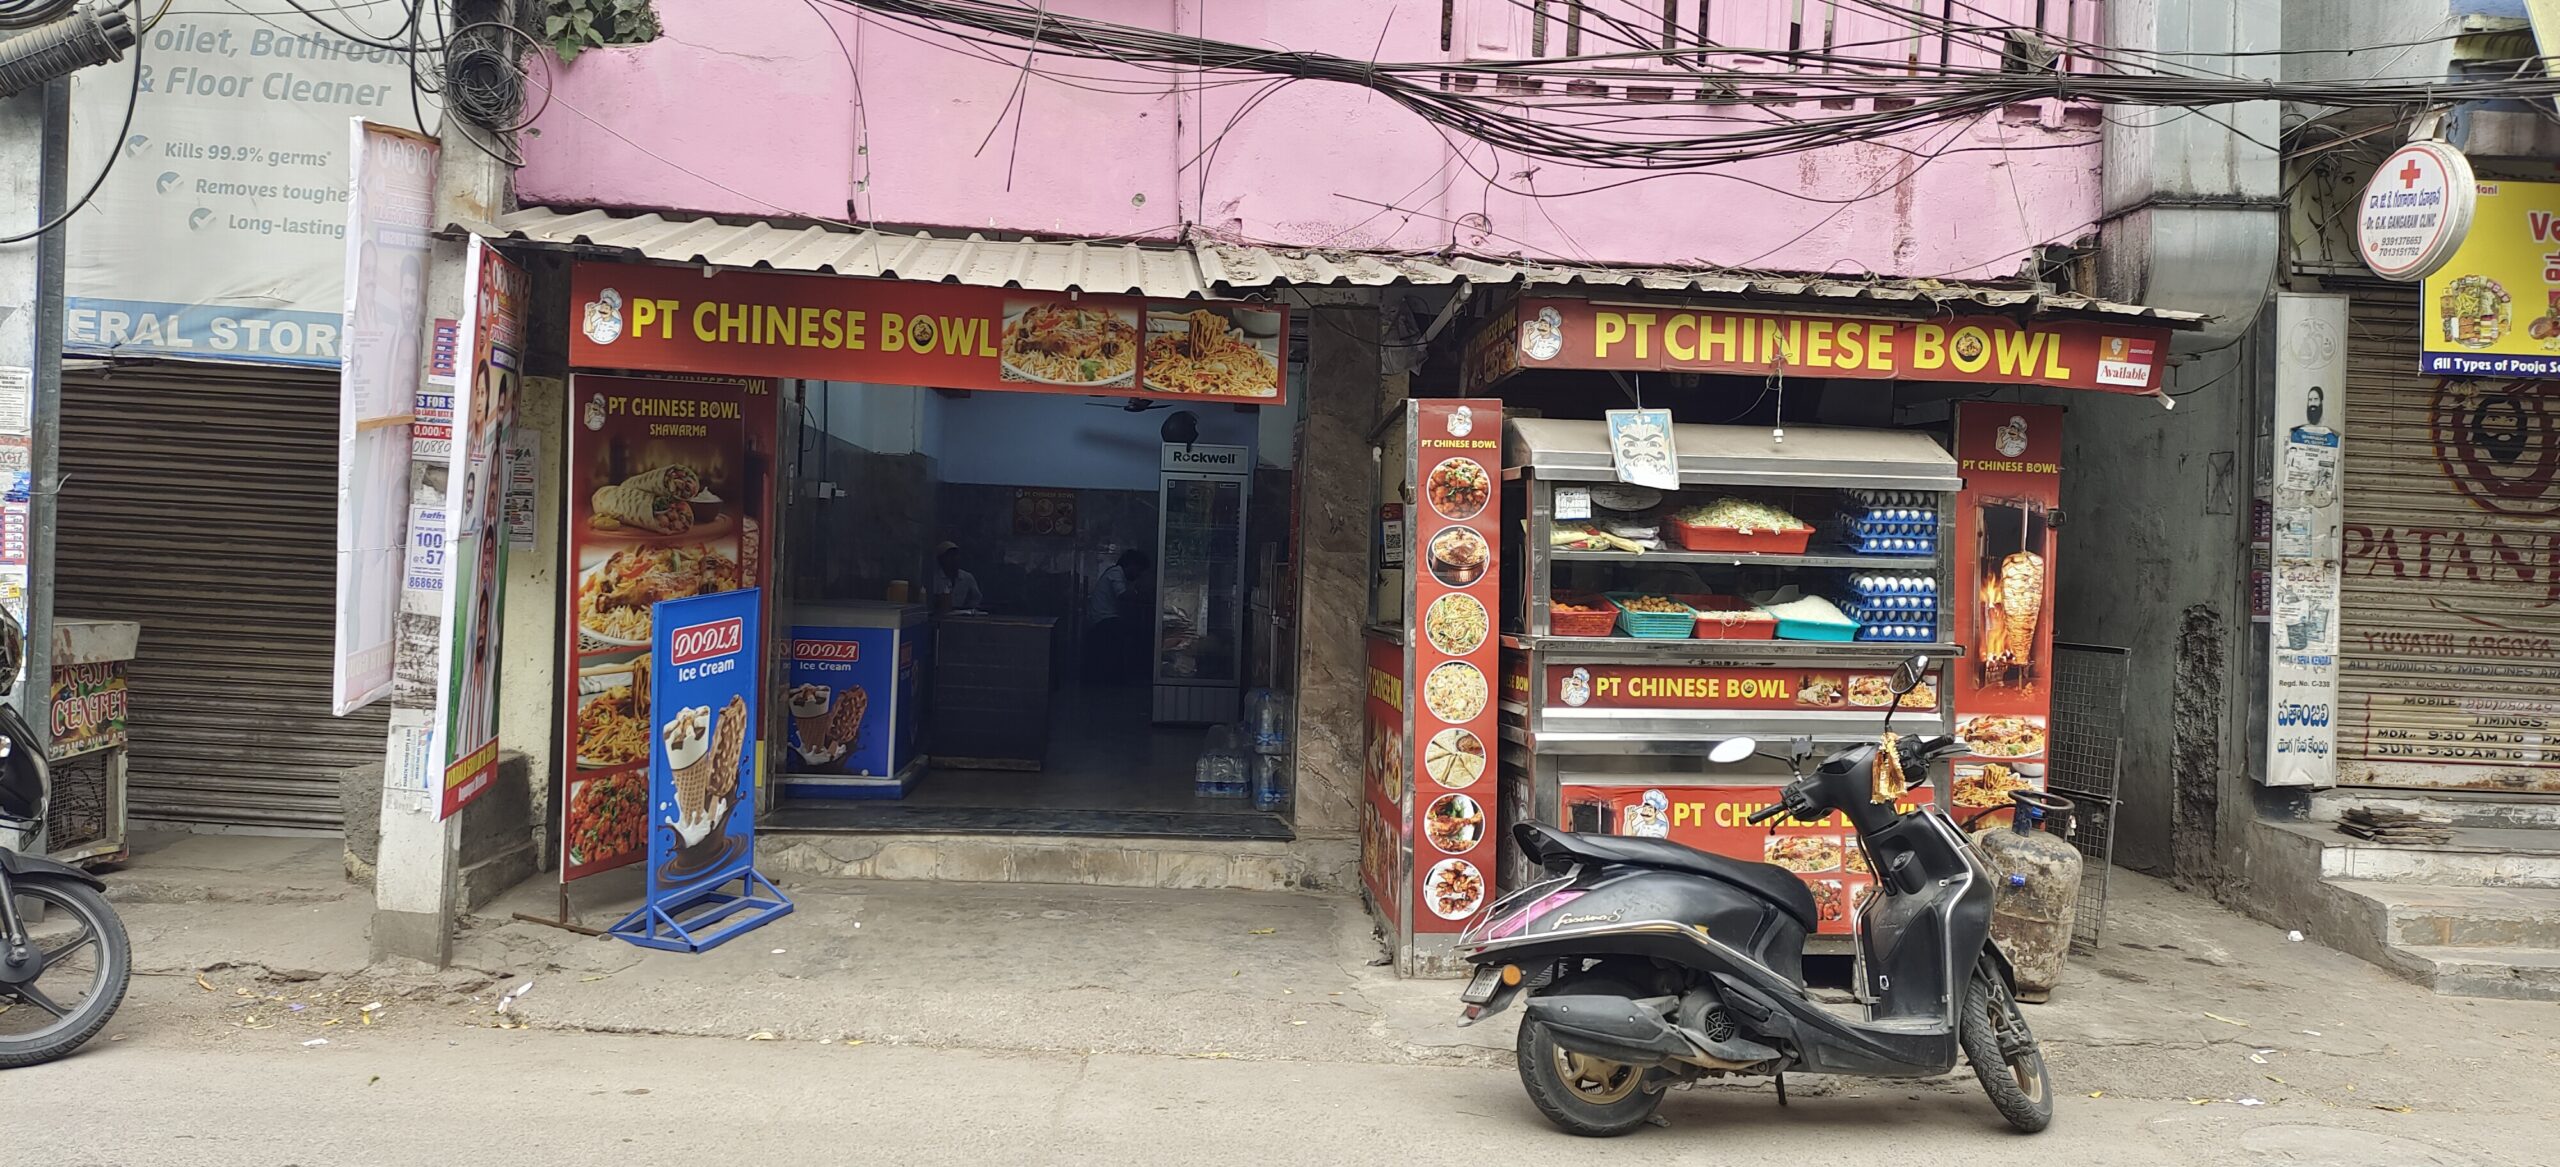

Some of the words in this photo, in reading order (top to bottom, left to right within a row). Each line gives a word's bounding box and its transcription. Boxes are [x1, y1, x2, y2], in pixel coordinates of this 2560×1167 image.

[141, 24, 239, 58] oilet,
[165, 66, 253, 98] Floor
[262, 72, 391, 106] Cleaner
[165, 142, 204, 159] Kills
[208, 144, 263, 163] 99.9%
[195, 178, 277, 199] Removes
[229, 214, 346, 240] Long-lasting
[67, 308, 193, 348] ERAL
[209, 316, 342, 357] STOR
[630, 298, 680, 340] PT
[693, 302, 866, 350] CHINESE
[881, 314, 998, 358] BOWL
[1595, 312, 1657, 360] PT
[1664, 313, 1893, 372] CHINESE
[1914, 323, 2071, 380] BOWL
[2101, 365, 2147, 381] Available
[2433, 358, 2450, 370] All
[2454, 358, 2491, 372] Types
[2494, 360, 2508, 371] of
[2511, 361, 2546, 374] Pooja
[427, 396, 446, 407] FOR
[608, 396, 627, 415] PT
[631, 398, 695, 418] CHINESE
[700, 401, 741, 419] BOWL
[650, 423, 707, 437] SHAWARMA
[1421, 439, 1432, 448] PT
[1434, 440, 1469, 448] CHINESE
[1472, 440, 1497, 448] BOWL
[1173, 451, 1236, 465] Rockwell
[1962, 459, 1976, 471] PT
[1978, 460, 2023, 472] CHINESE
[2026, 463, 2058, 474] BOWL
[416, 532, 443, 548] 100
[675, 624, 739, 658] DODLA
[796, 644, 856, 660] DODLA
[679, 667, 697, 683] Ice
[699, 658, 735, 678] Cream
[800, 662, 816, 671] Ice
[818, 662, 851, 671] Cream
[1596, 679, 1619, 696] PT
[1627, 678, 1719, 698] CHINESE
[1741, 679, 1789, 699] BOWL
[52, 688, 128, 736] CENTER
[2472, 732, 2498, 743] AM
[2507, 734, 2524, 743] TO
[2470, 749, 2497, 758] AM
[2507, 751, 2524, 759] TO
[1673, 802, 1705, 827] PT
